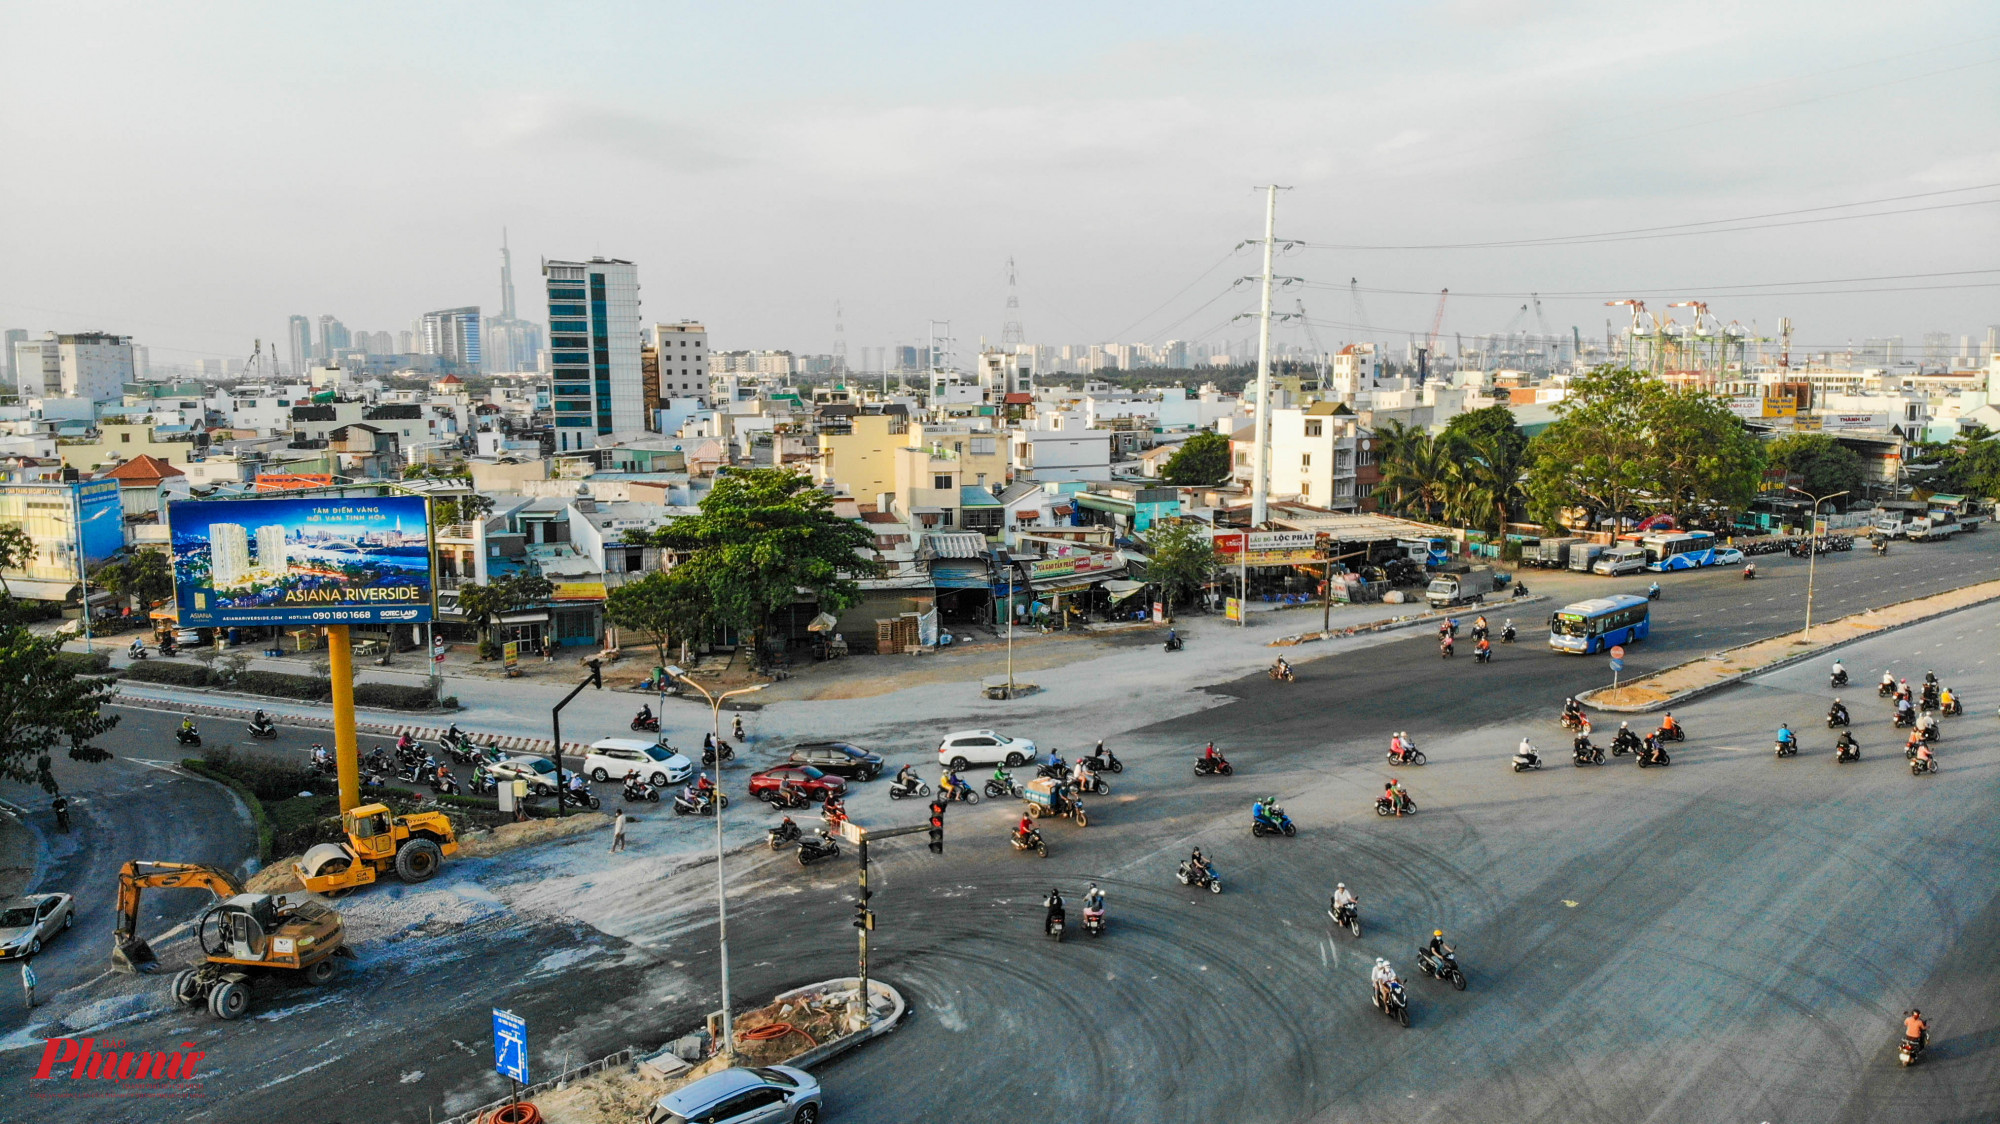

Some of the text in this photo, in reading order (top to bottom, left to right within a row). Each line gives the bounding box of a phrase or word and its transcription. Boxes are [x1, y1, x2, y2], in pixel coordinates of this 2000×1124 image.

[1274, 533, 1290, 542] LỘC
[1292, 533, 1315, 541] PHÁT
[285, 587, 420, 602] ASIANA RIVERSIDE
[312, 611, 331, 620] 090
[332, 611, 349, 620] 180
[350, 611, 371, 619] 1668
[400, 609, 418, 617] LAND
